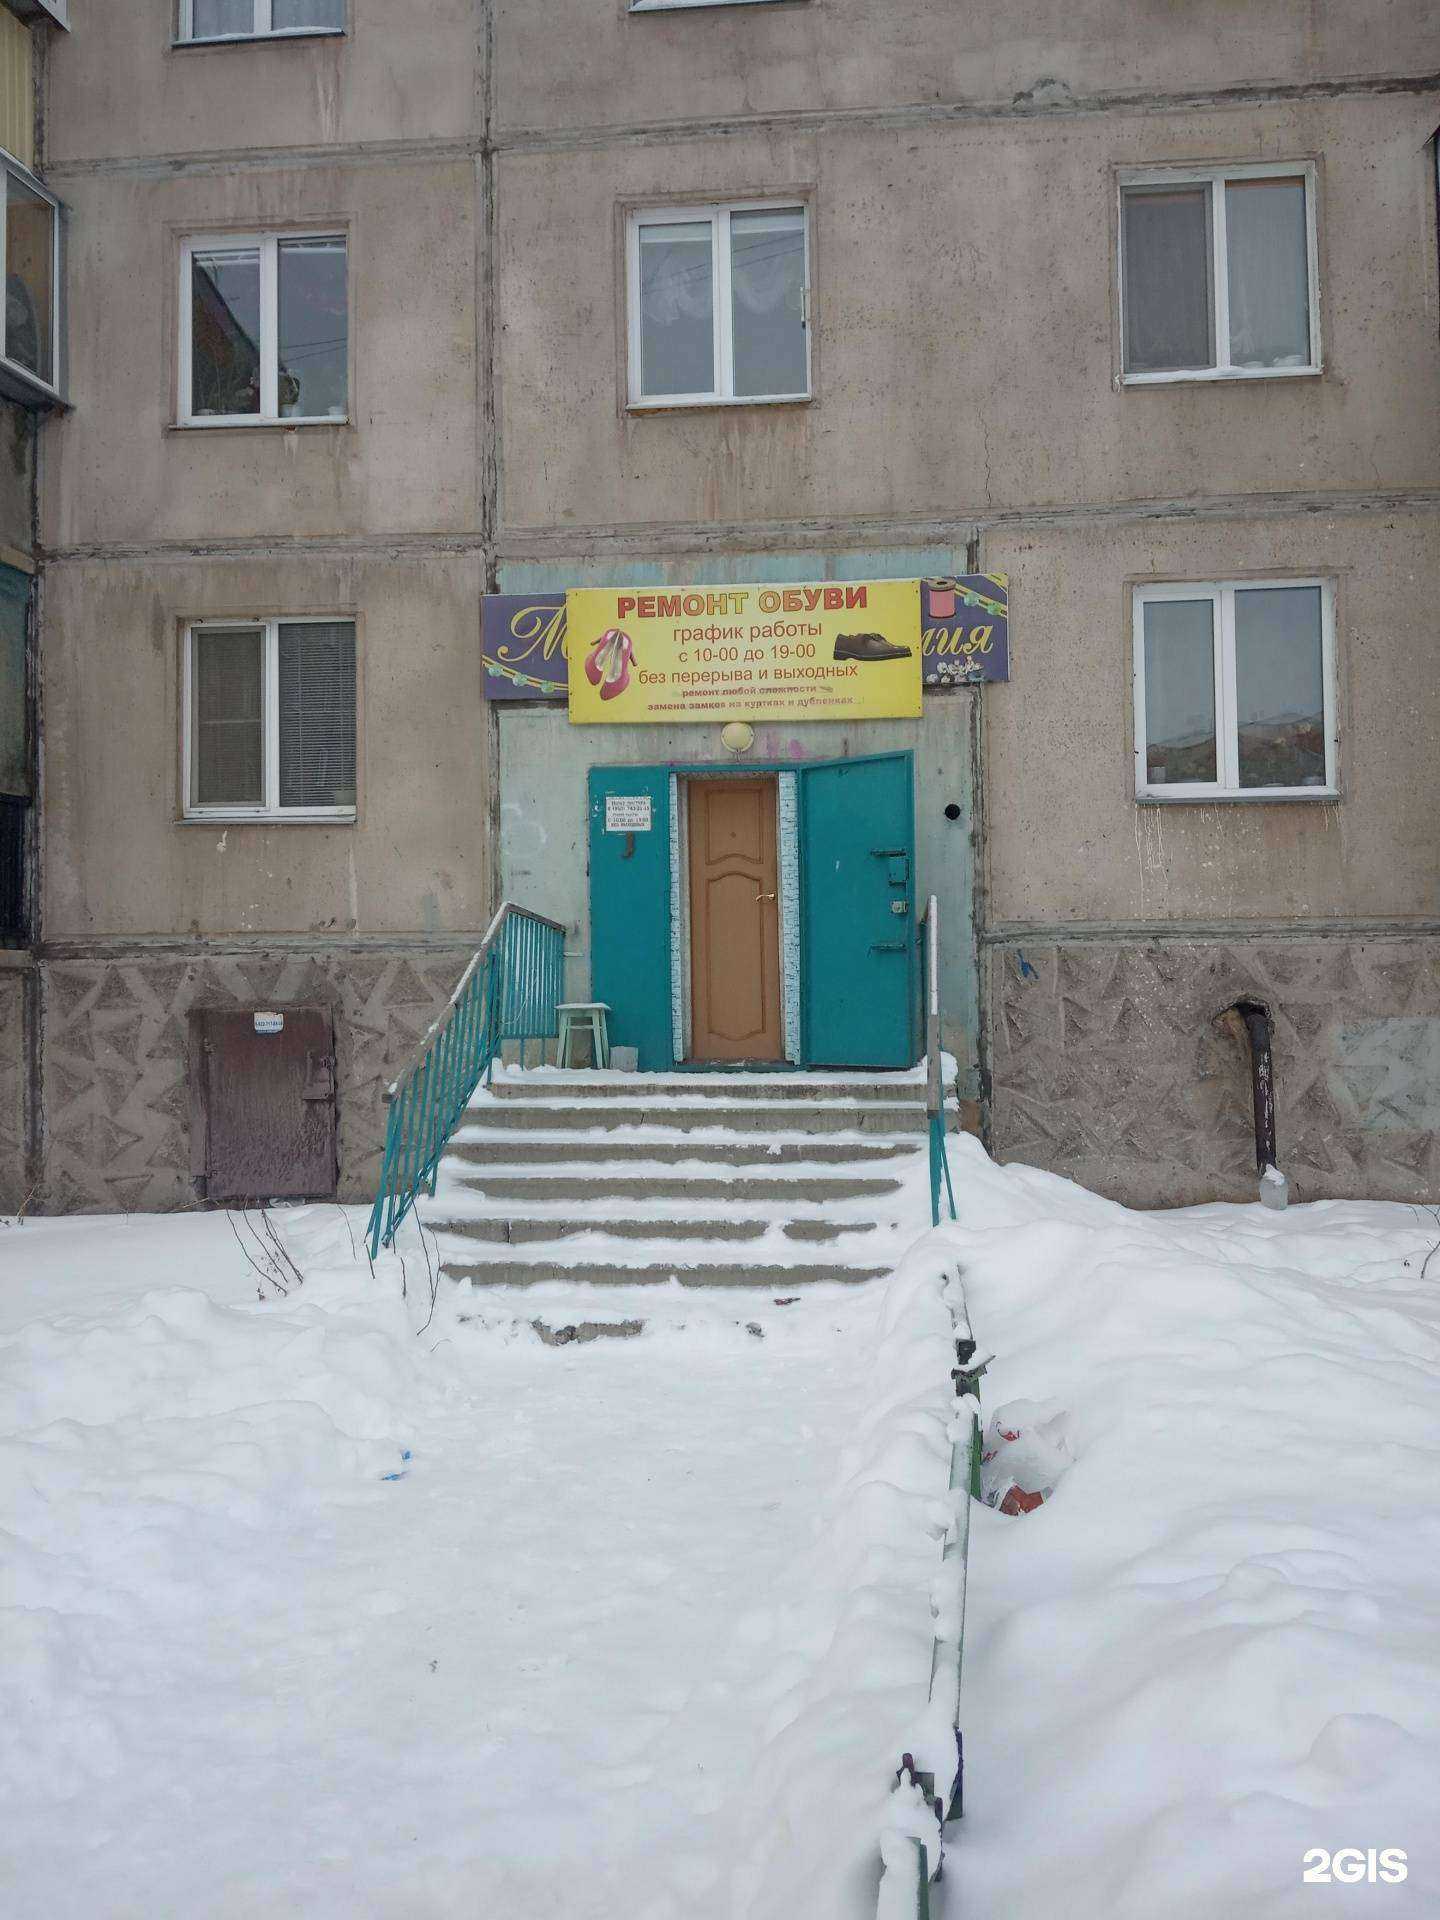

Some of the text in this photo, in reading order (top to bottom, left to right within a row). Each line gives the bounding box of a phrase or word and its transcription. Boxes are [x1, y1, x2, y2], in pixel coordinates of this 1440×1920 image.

[617, 586, 868, 619] РЕМОНТ ОБУВИ
[673, 621, 822, 643] график работы
[679, 643, 816, 663] с 10-00 до 19-00
[639, 664, 858, 686] без перерыва и выходных
[682, 689, 720, 698] ремонт
[648, 703, 686, 711] замена
